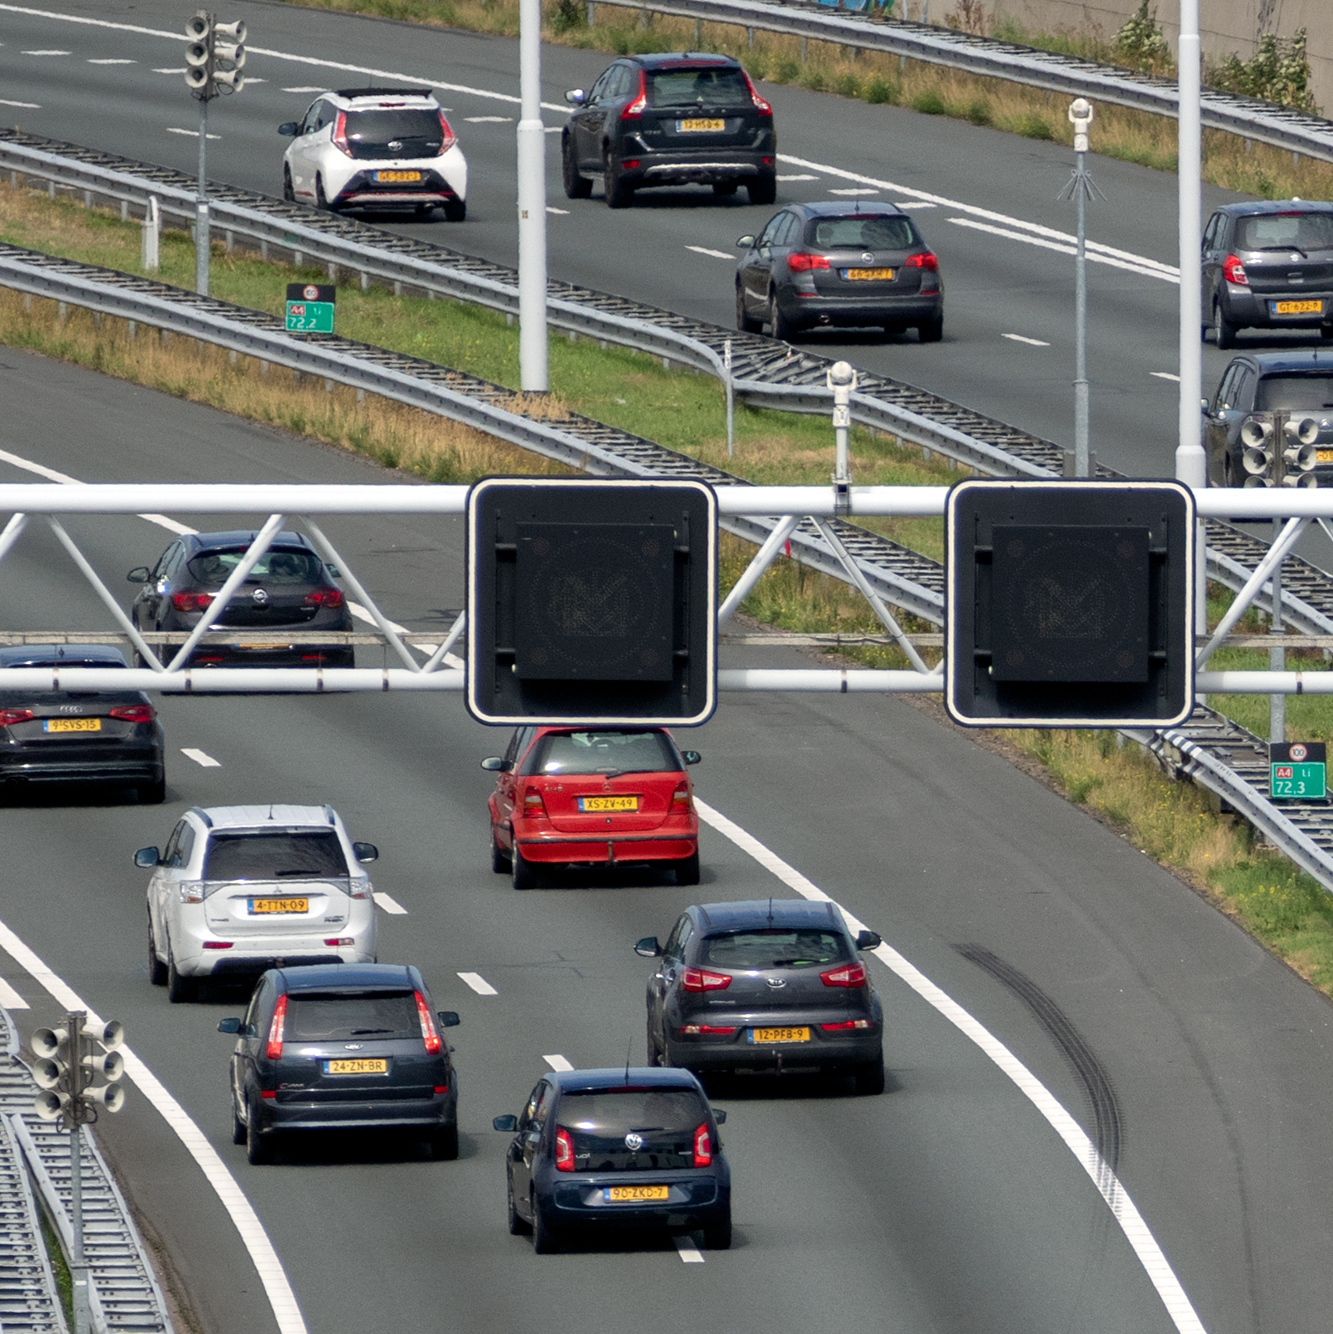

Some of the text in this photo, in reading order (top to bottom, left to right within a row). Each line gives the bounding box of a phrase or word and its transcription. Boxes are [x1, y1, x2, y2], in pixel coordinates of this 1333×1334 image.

[53, 719, 97, 731] 9-SVS-15
[1278, 768, 1291, 777] A4
[1276, 781, 1305, 795] 72,3
[587, 798, 633, 810] XS-ZV-49
[256, 900, 305, 911] 4-TTN-09
[758, 1028, 804, 1041] 12-PFB-9
[333, 1060, 383, 1072] 24-ZN-BR
[613, 1186, 664, 1199] 90-ZKD-7
